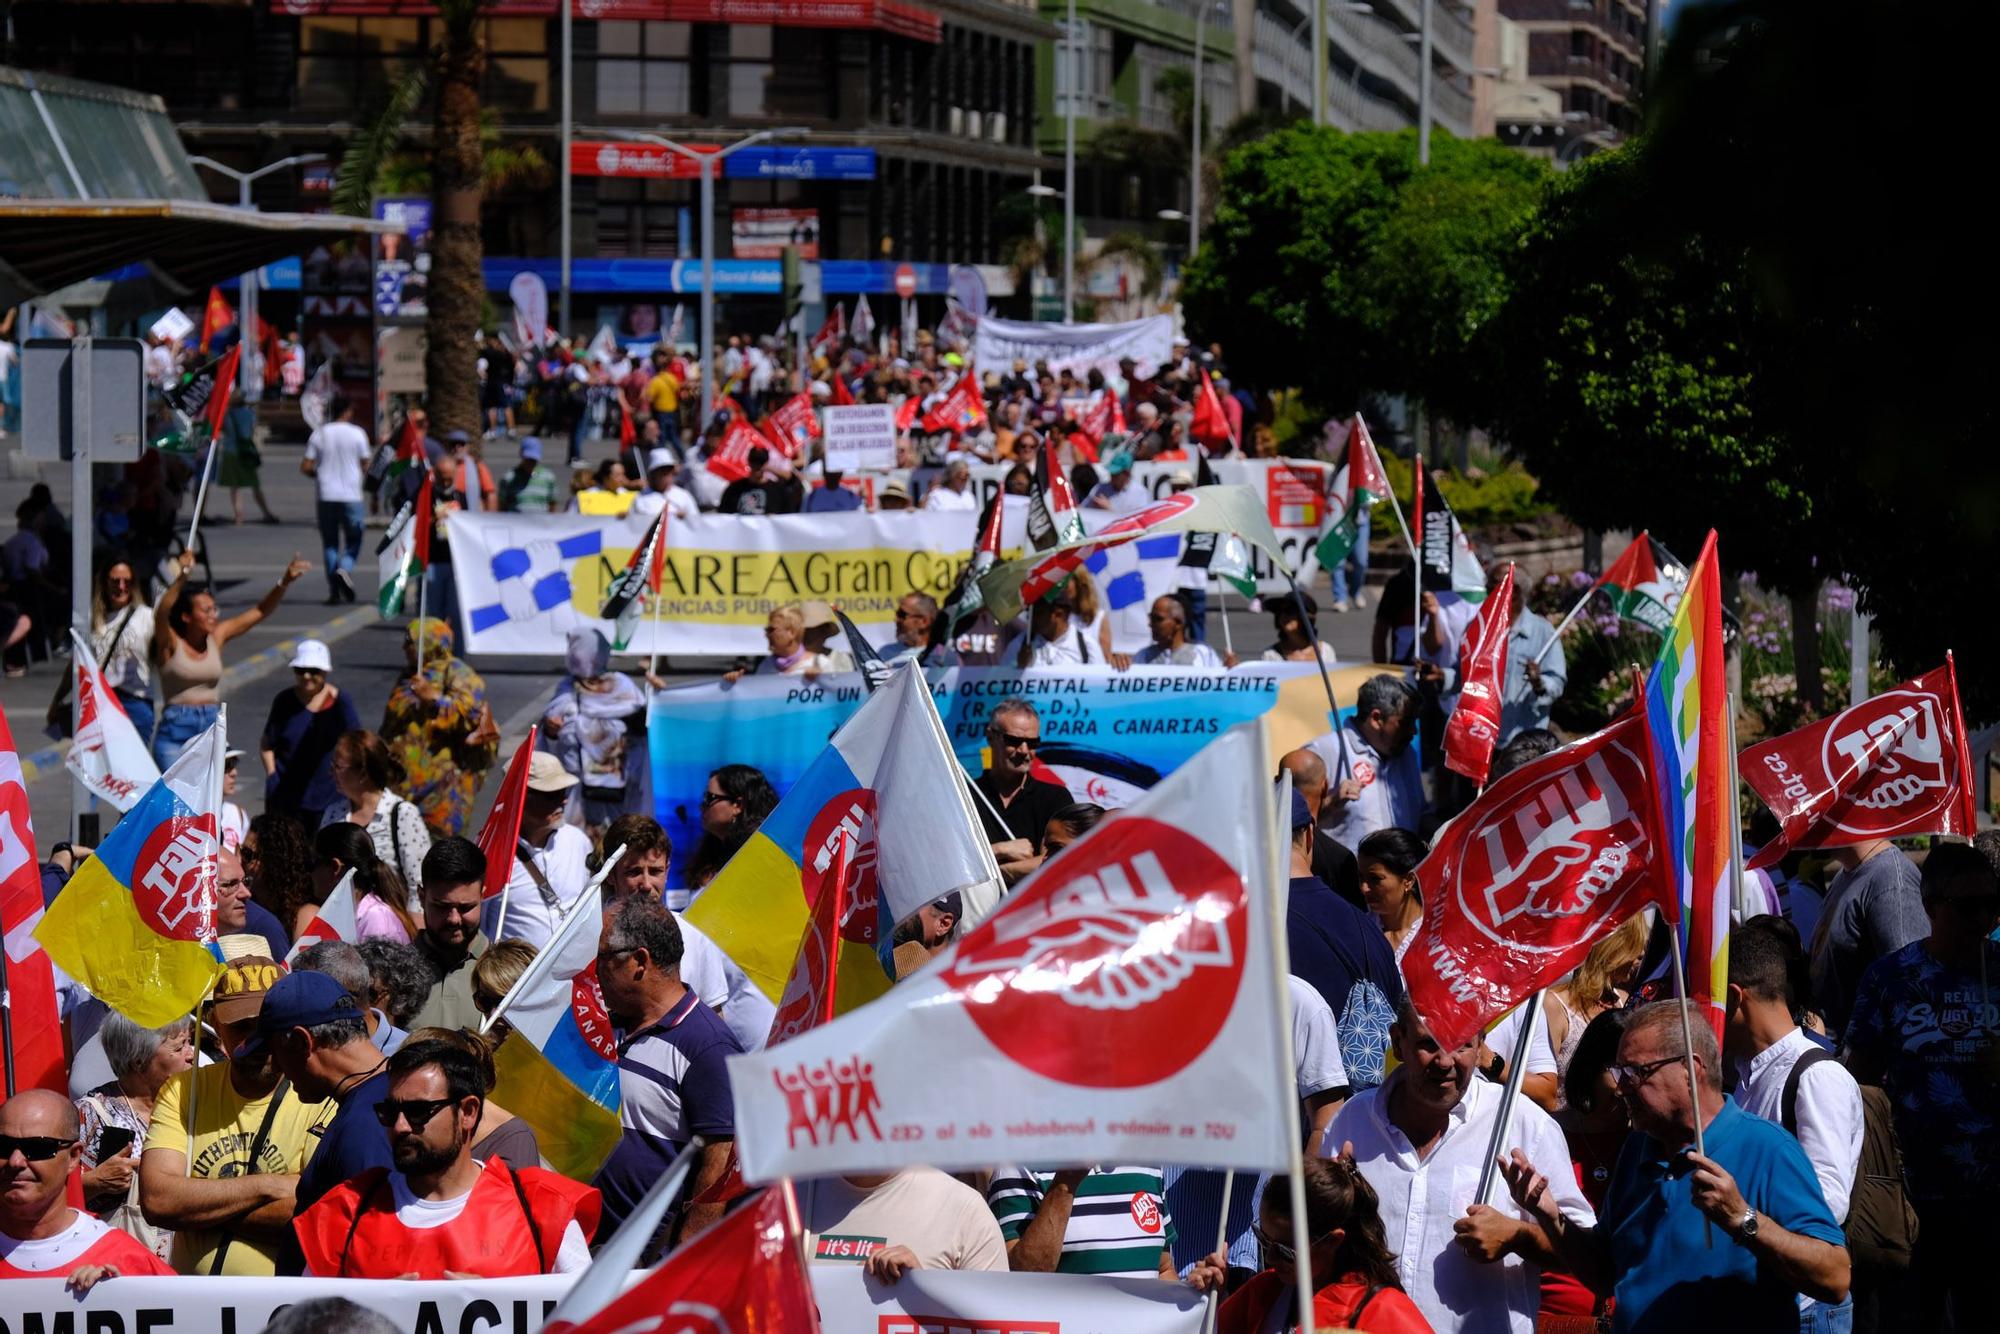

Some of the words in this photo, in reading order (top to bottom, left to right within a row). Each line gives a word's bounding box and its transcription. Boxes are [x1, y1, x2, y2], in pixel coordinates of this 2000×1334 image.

[806, 551, 892, 594] Gran
[835, 597, 898, 611] DIGNA
[786, 688, 824, 704] POR
[837, 686, 861, 702] UN
[960, 678, 1089, 697] OCCIDENTAL
[1105, 676, 1277, 693] INDEPENDIENTE
[1045, 720, 1098, 736] PARA
[1113, 718, 1219, 735] CANARIAS
[225, 964, 278, 994] NYC
[1944, 992, 1980, 1003] REAL
[576, 990, 613, 1055] CANAR
[1941, 1009, 1969, 1023] UGT
[1133, 1193, 1153, 1218] UGT
[825, 1238, 852, 1257] it's
[855, 1239, 874, 1257] lit
